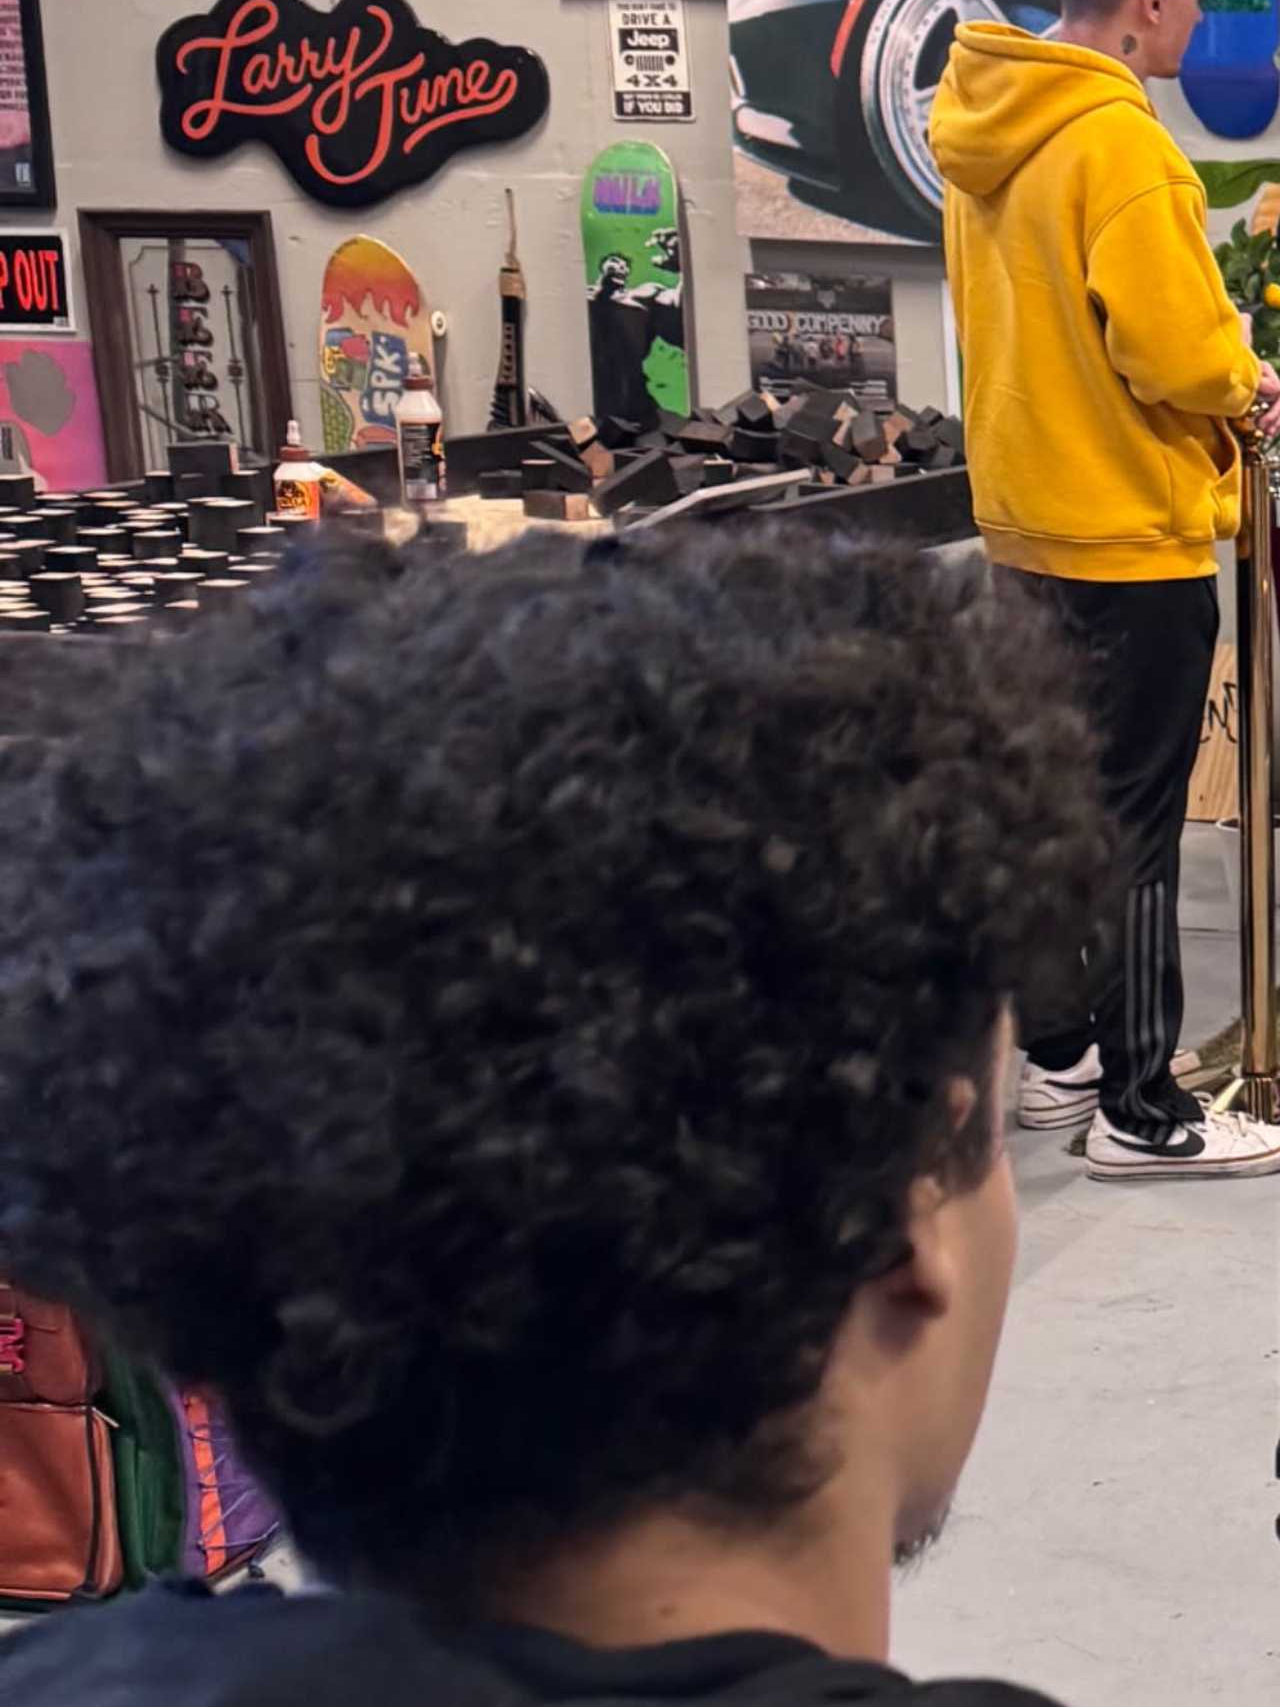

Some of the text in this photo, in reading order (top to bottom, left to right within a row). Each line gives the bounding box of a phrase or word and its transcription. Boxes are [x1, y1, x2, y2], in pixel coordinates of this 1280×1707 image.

[622, 12, 672, 26] DRIVE A
[626, 29, 670, 49] Jeep
[637, 101, 662, 114] YOU
[305, 53, 518, 184] June
[14, 248, 60, 312] OUT
